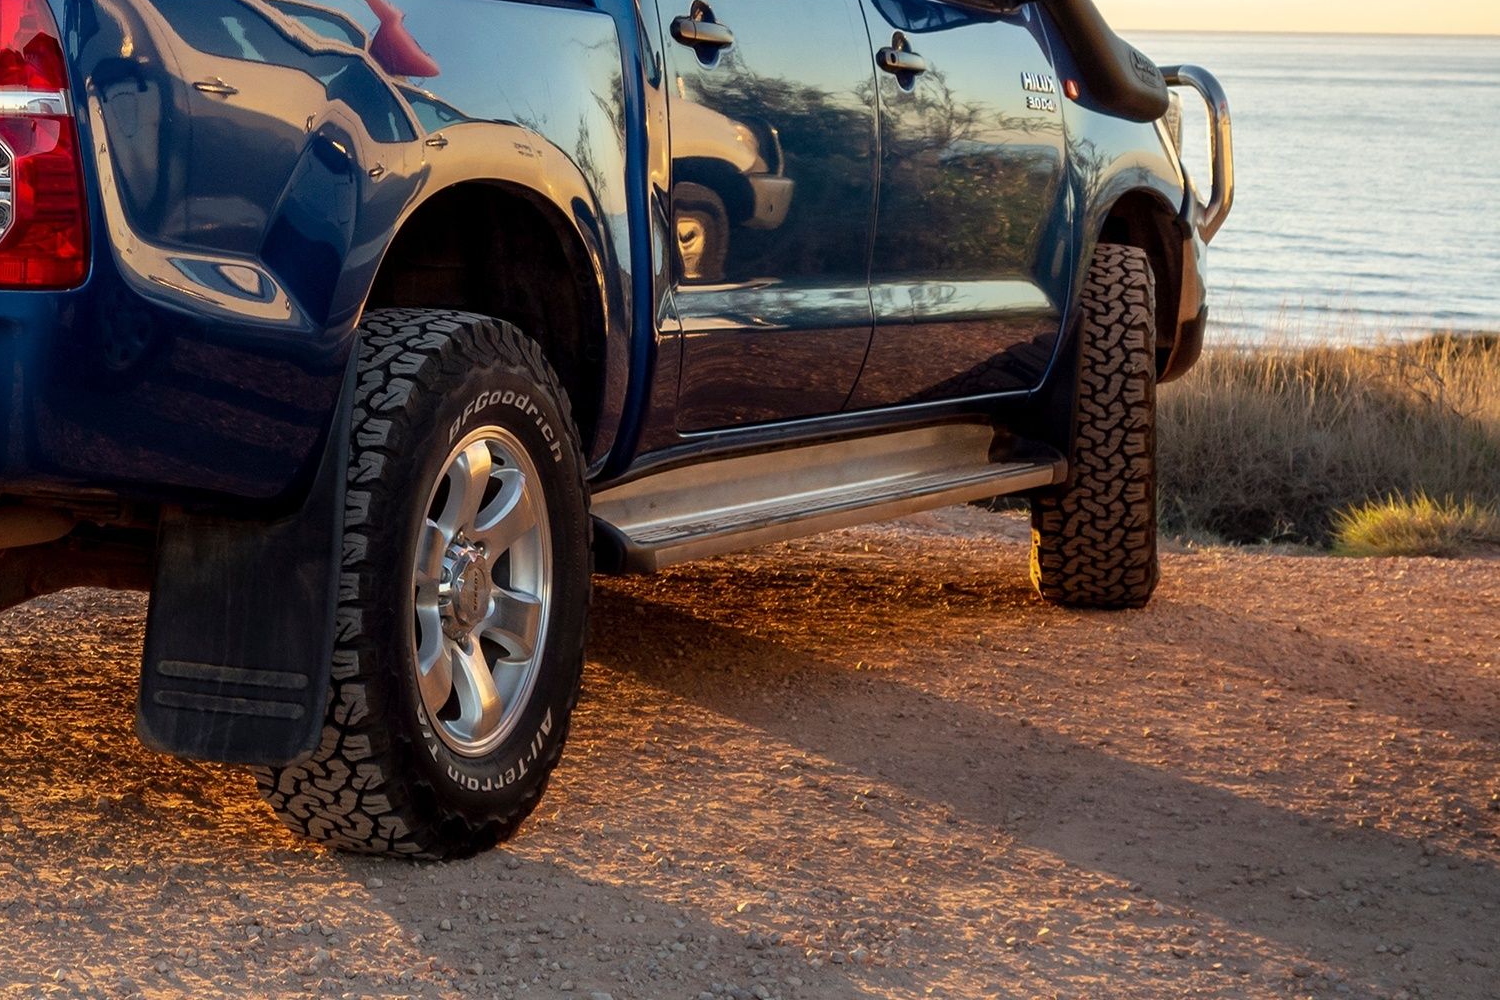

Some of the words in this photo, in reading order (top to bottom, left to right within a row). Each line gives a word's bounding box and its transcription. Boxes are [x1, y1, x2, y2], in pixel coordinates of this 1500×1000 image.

[1021, 71, 1056, 94] HILUX
[448, 390, 563, 463] BFGoodrich
[446, 706, 553, 792] All-Terrain
